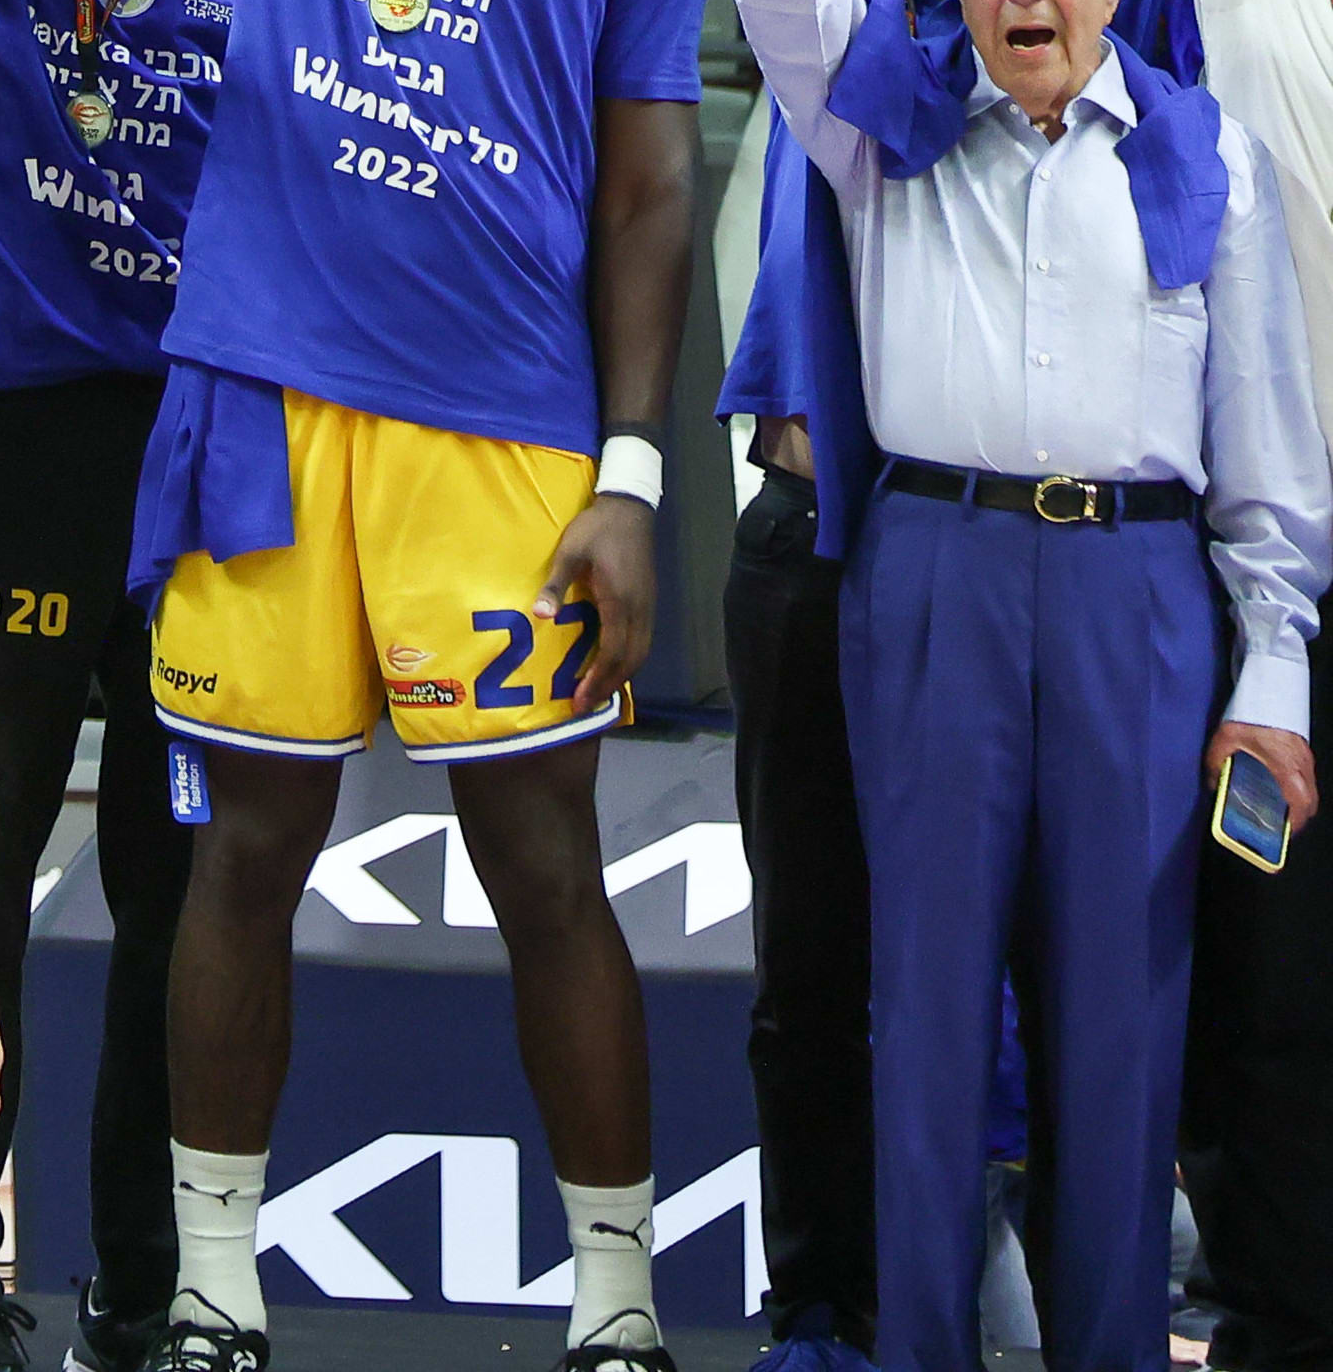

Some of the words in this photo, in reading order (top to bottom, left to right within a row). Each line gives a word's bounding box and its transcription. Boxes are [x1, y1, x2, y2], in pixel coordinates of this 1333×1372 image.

[143, 49, 223, 84] מכבי
[132, 74, 182, 115] תל
[292, 46, 463, 155] Winner
[463, 125, 520, 175] סל
[332, 138, 440, 199] 2022
[89, 240, 181, 286] 2022
[6, 588, 69, 638] 20
[157, 656, 218, 695] Rapyd
[471, 600, 601, 708] 22
[388, 688, 437, 704] inner
[176, 753, 189, 815] Perfect
